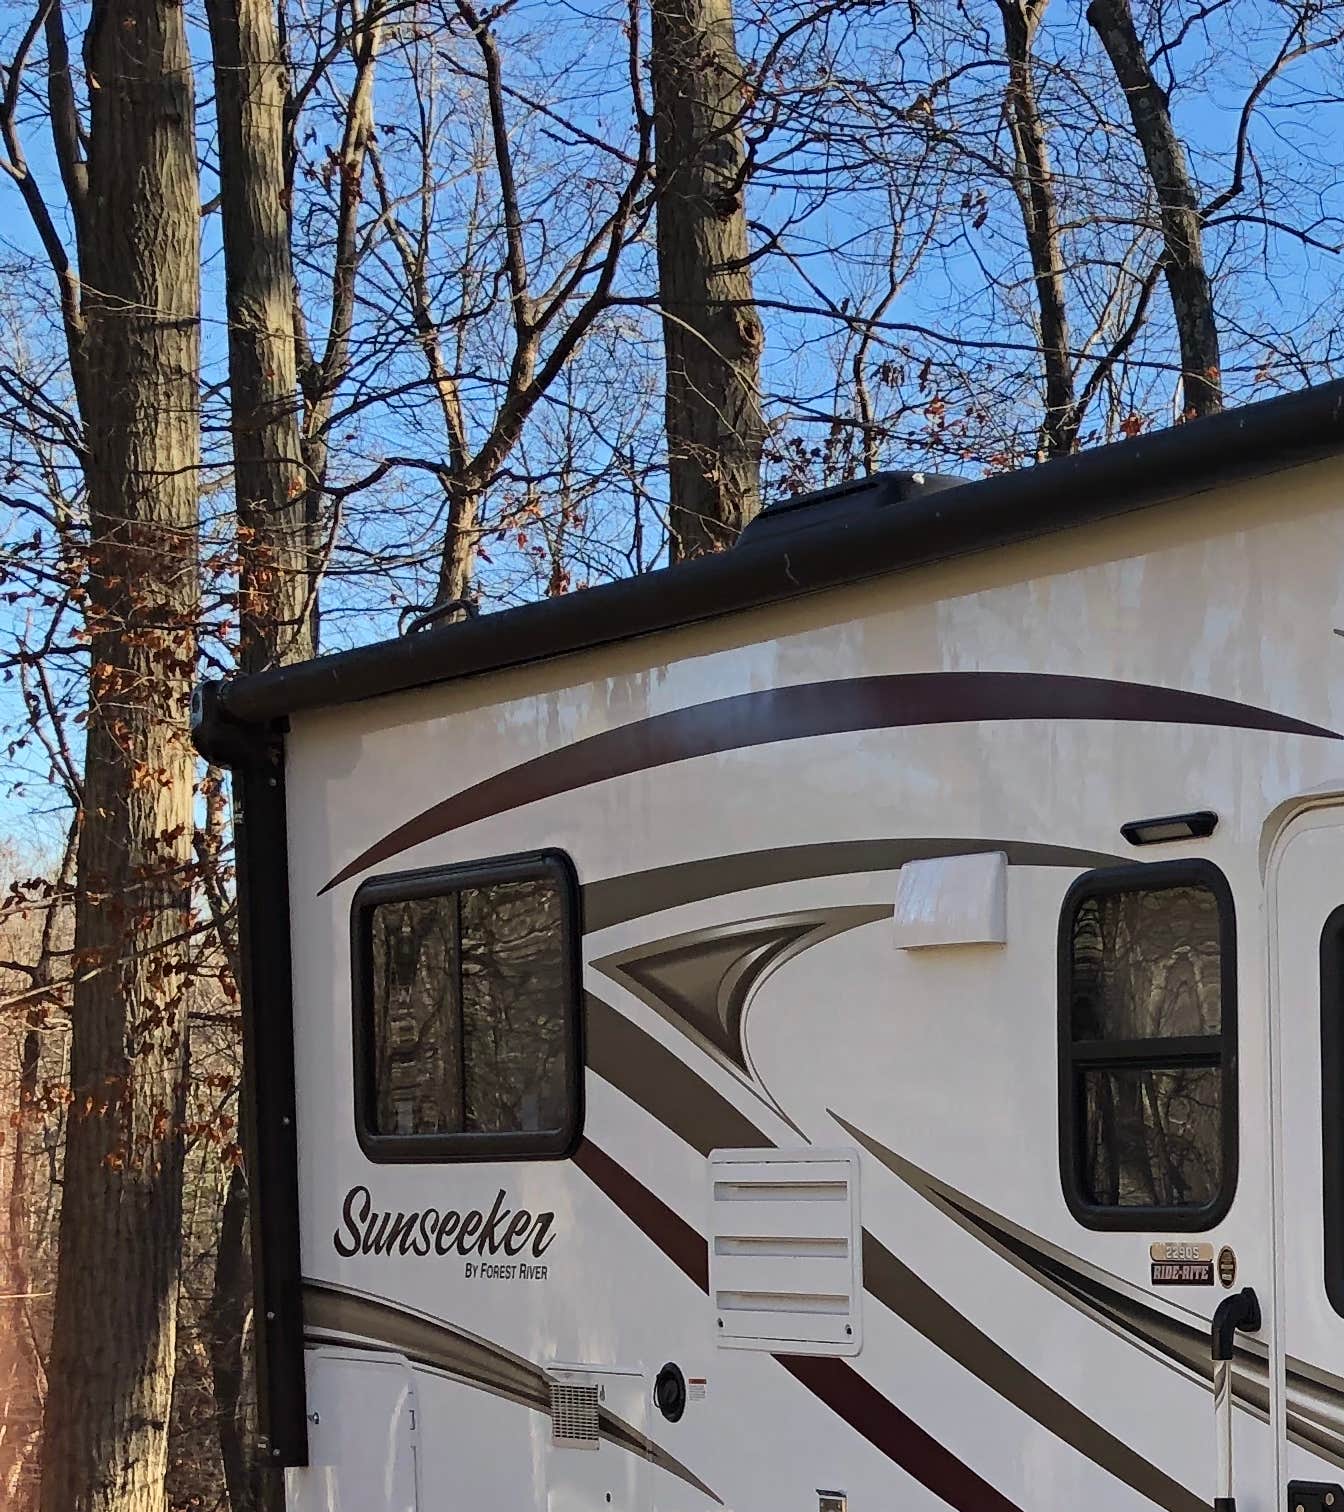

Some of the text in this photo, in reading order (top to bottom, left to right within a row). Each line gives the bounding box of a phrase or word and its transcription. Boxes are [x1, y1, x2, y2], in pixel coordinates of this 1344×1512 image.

[333, 1185, 557, 1258] Sunseeker
[465, 1262, 548, 1281] BY FOREST RIVER
